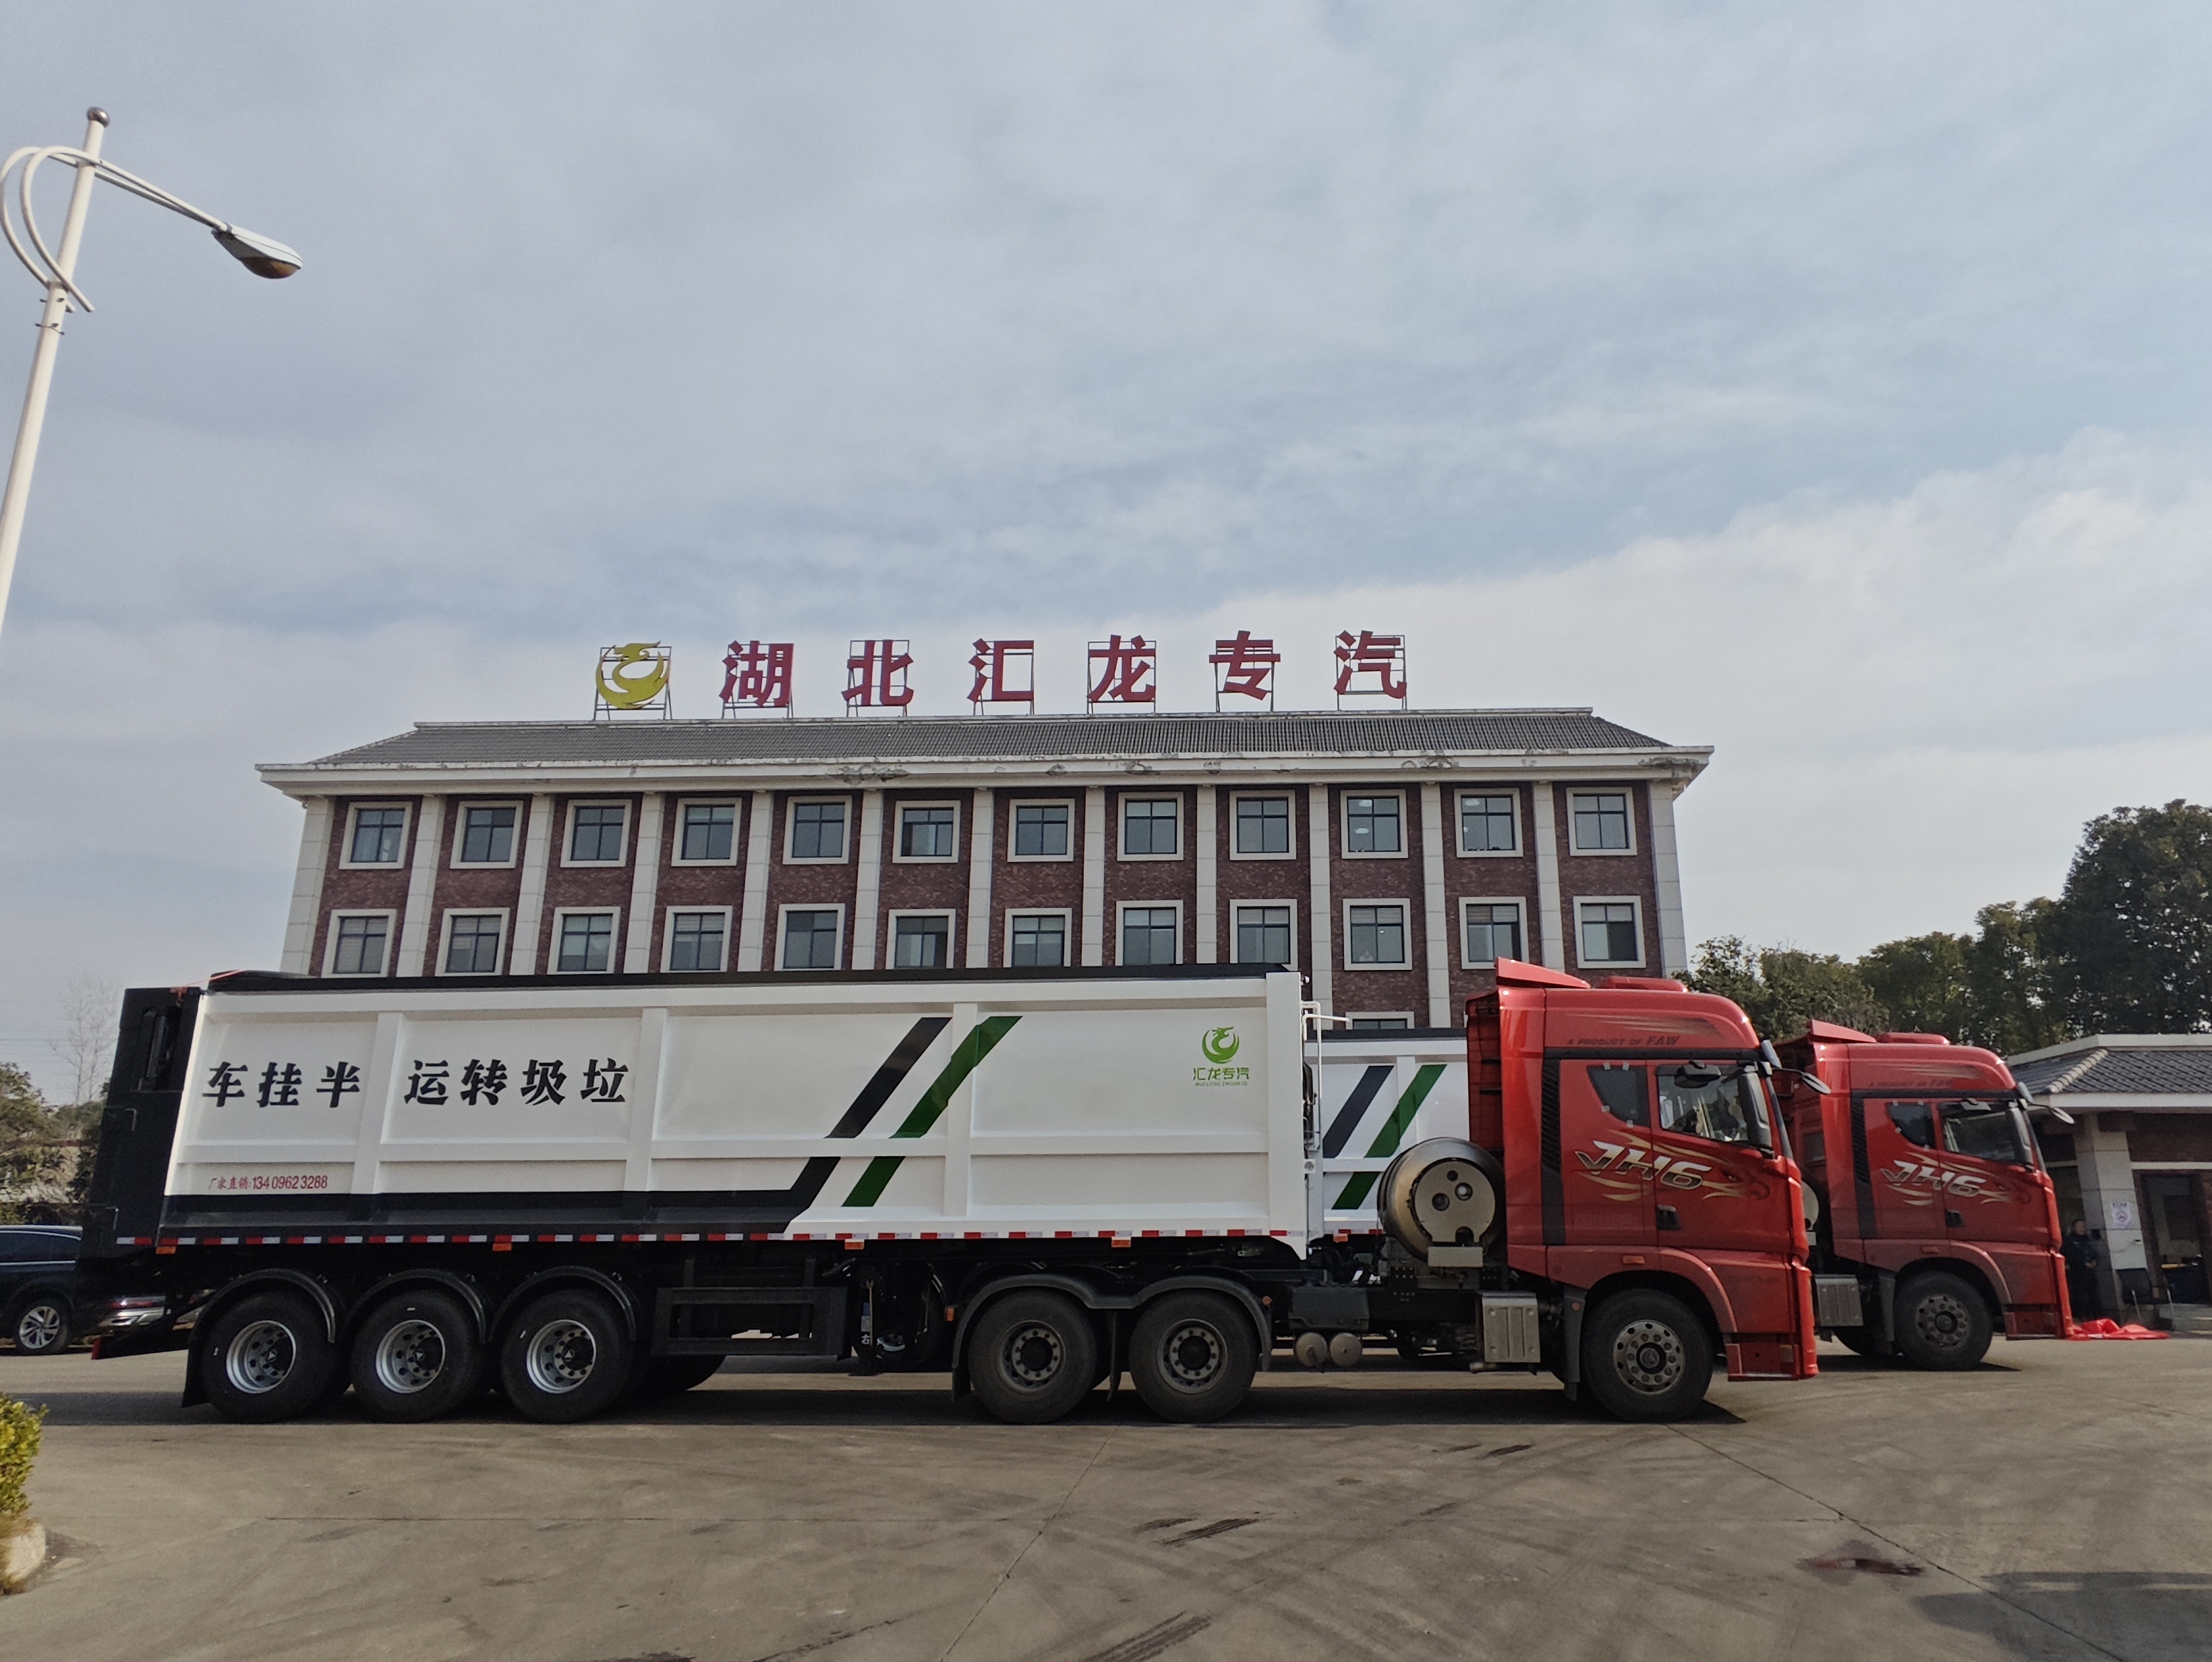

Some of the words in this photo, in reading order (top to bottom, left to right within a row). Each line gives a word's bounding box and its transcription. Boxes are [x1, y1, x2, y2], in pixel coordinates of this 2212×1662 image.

[719, 630, 1407, 707] 湖北汇龙专汽
[1646, 1035, 1681, 1045] FAW
[1193, 1067, 1250, 1081] 汇龙专汽
[1575, 1140, 1712, 1190] JH6
[1880, 1159, 1987, 1197] JH6
